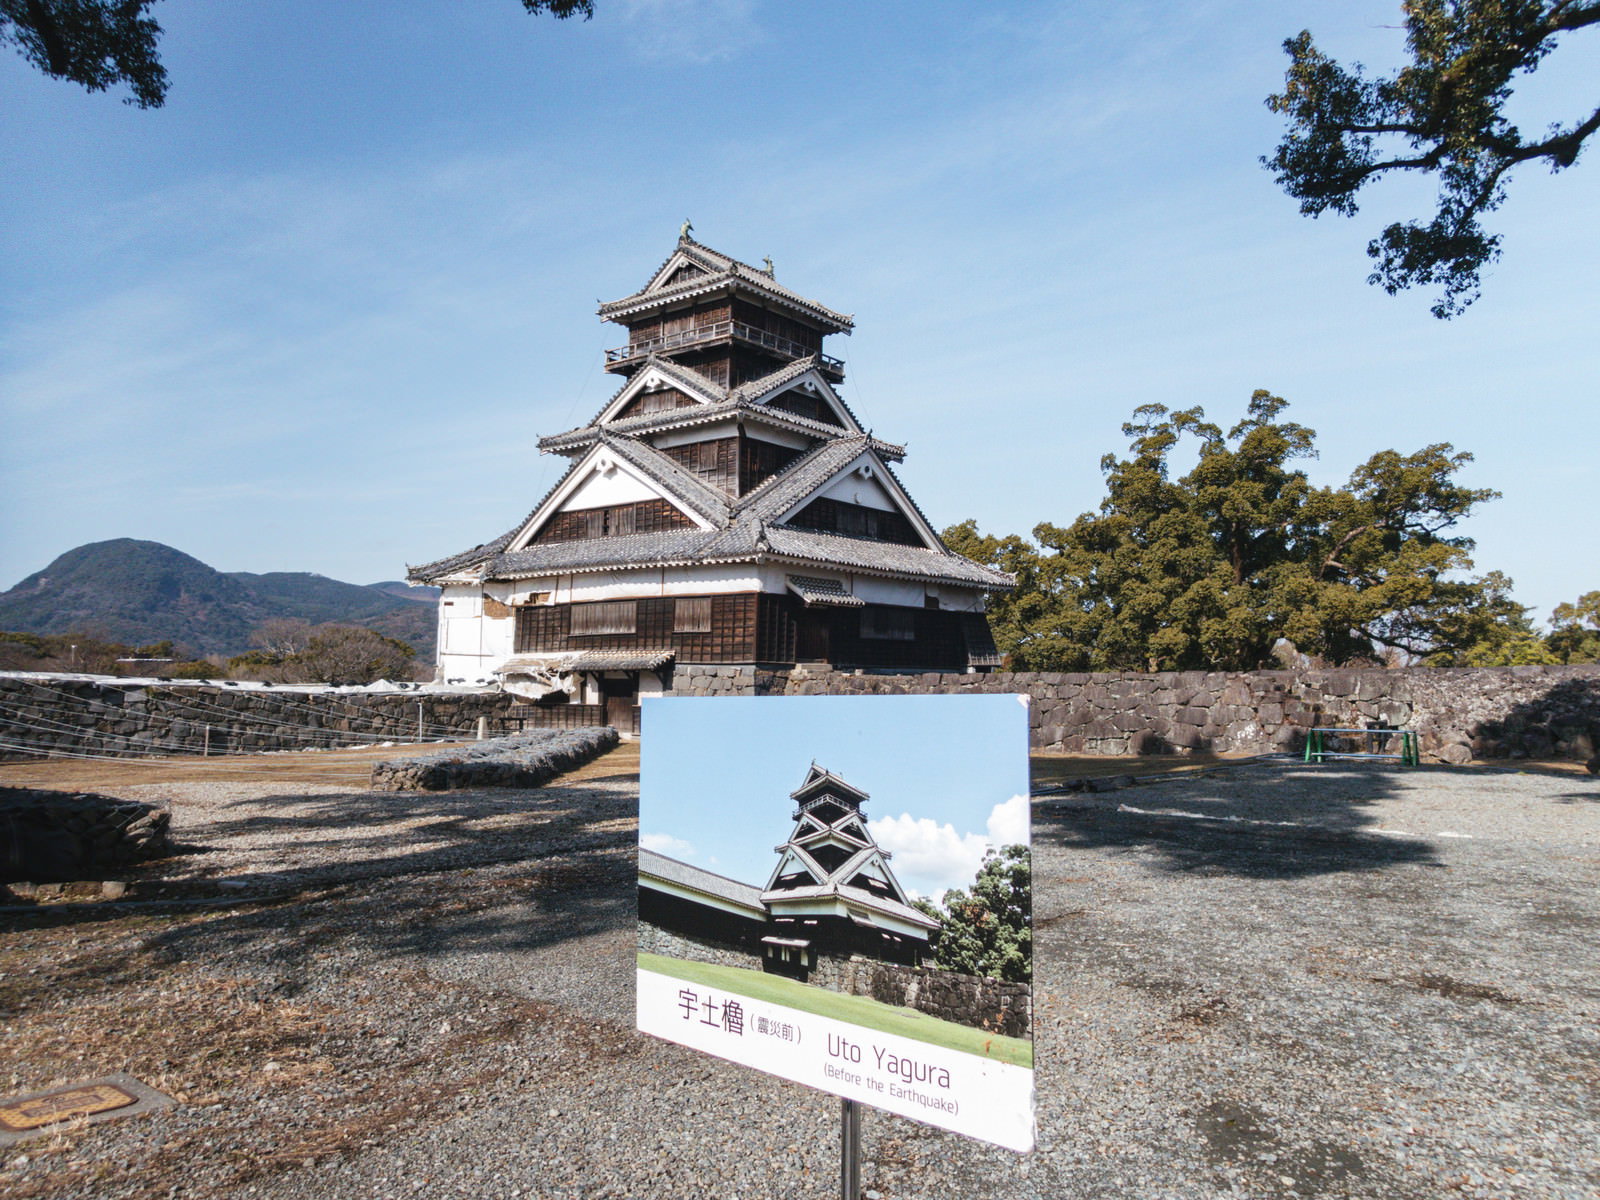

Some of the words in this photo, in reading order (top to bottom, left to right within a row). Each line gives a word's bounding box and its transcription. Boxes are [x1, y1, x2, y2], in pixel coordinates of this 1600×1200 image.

[677, 988, 745, 1037] 宇土櫓
[827, 1032, 861, 1064] Uto
[872, 1045, 950, 1089] Yagura
[823, 1062, 862, 1086] (Before
[866, 1077, 885, 1093] the
[889, 1082, 960, 1116] Earthquake)
